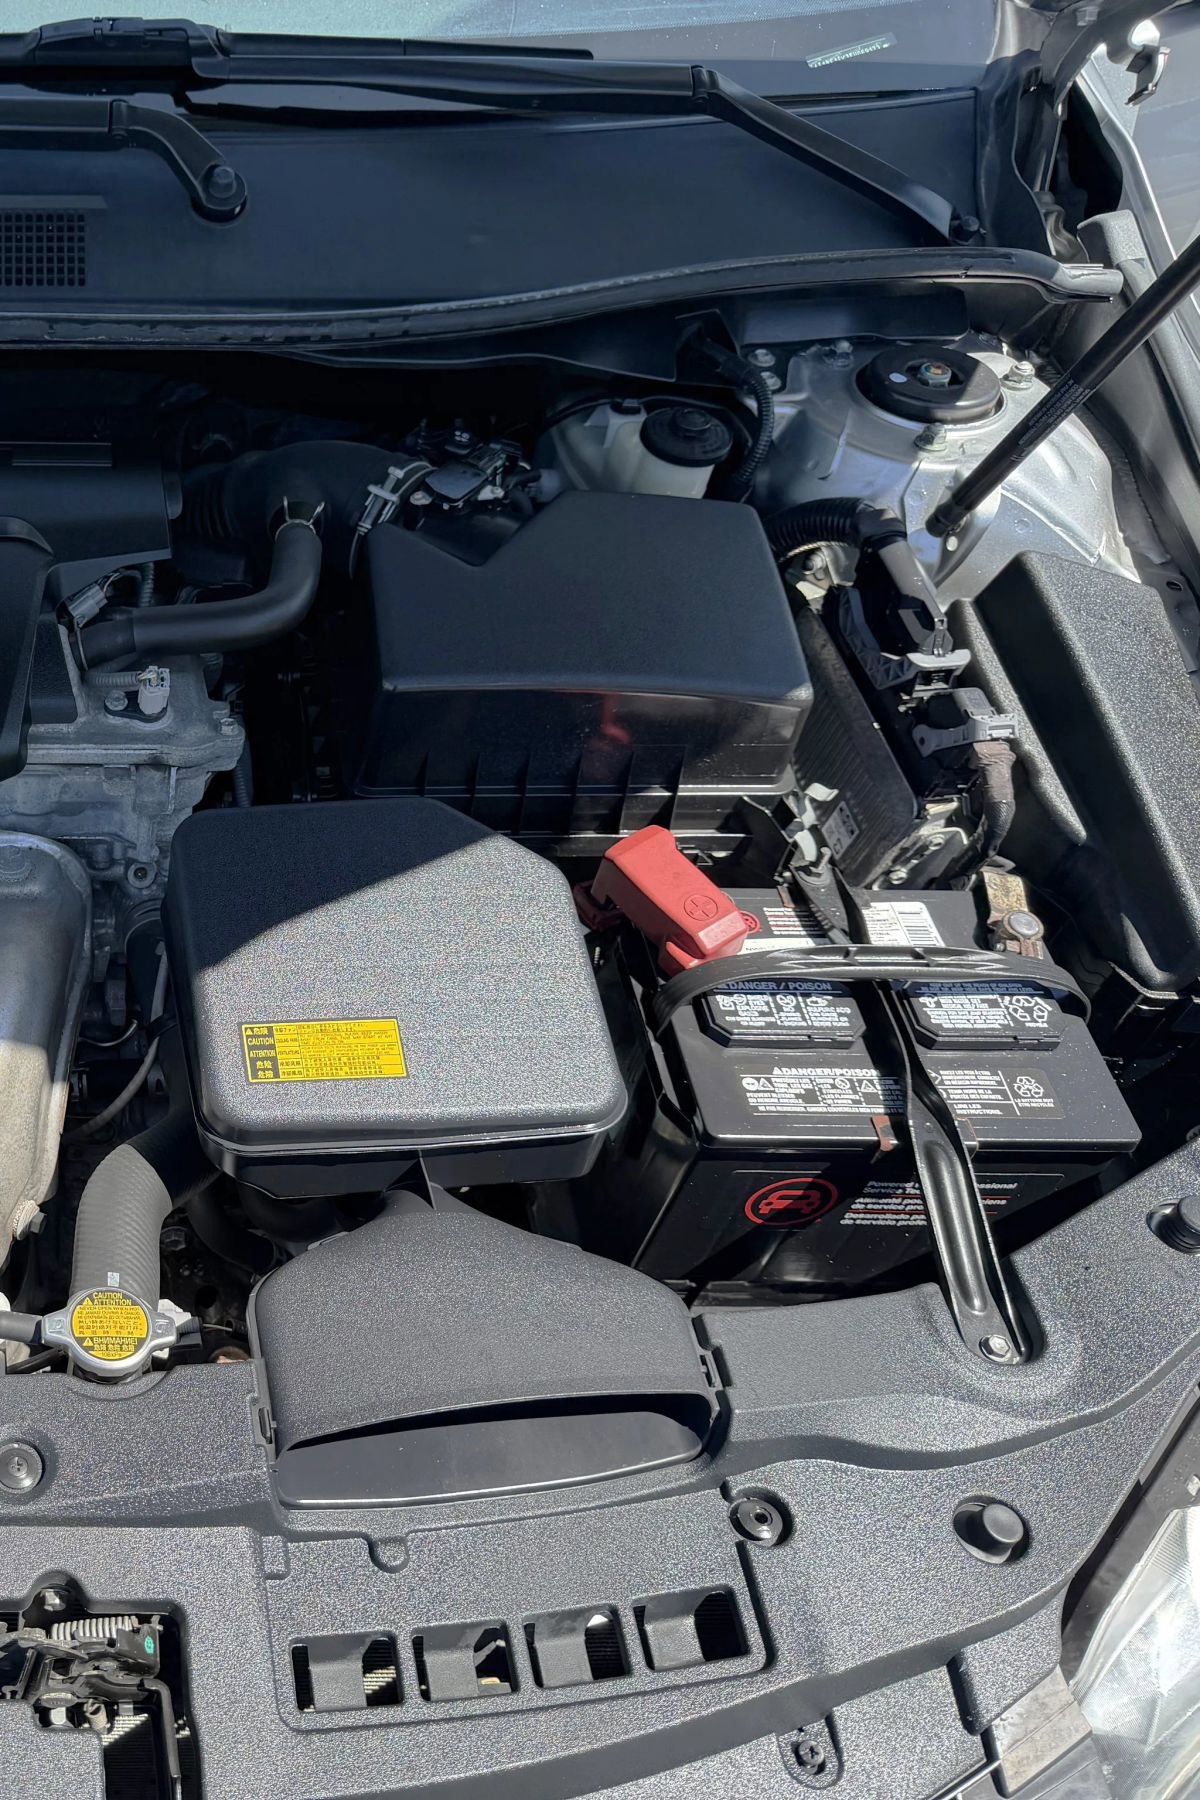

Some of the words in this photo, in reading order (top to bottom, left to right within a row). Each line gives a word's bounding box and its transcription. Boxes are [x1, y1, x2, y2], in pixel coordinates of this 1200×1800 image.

[729, 982, 777, 991] DANGER
[788, 982, 833, 991] POISON
[248, 1037, 275, 1046] CAUTION
[250, 1049, 276, 1058] ATTENTION
